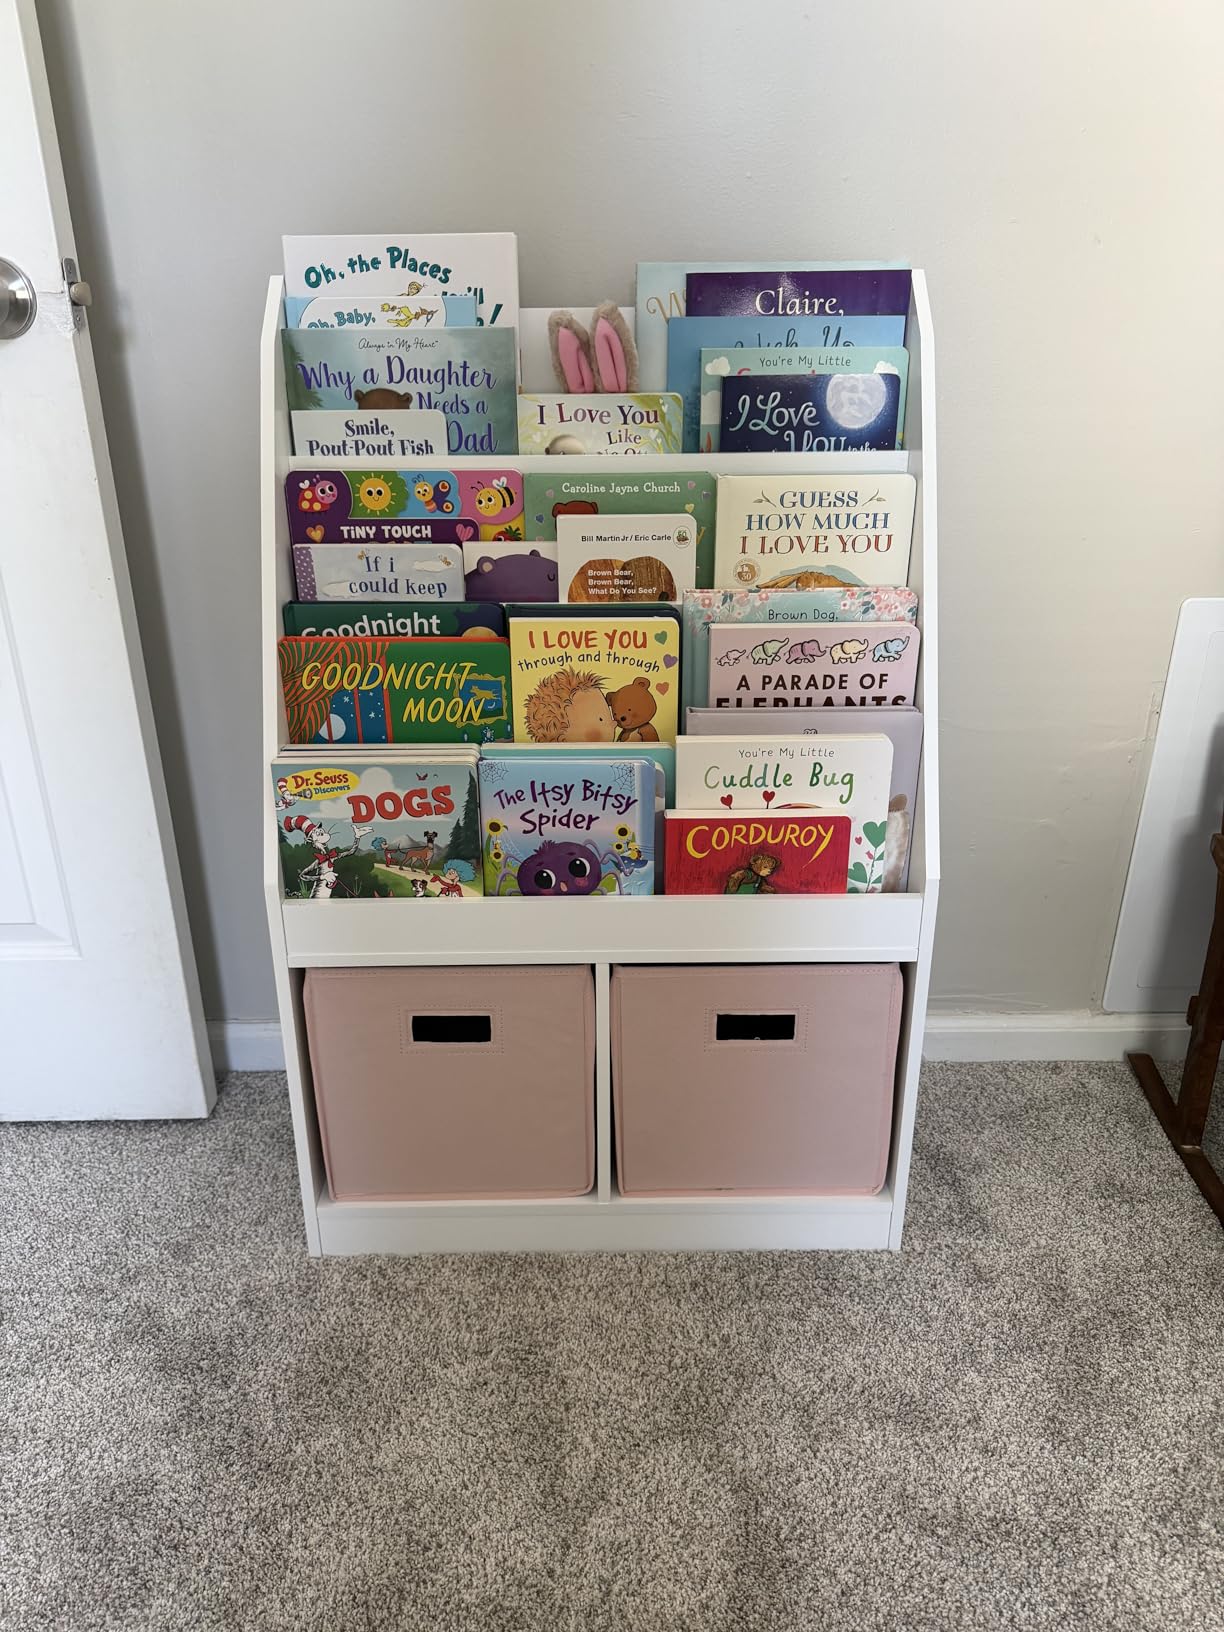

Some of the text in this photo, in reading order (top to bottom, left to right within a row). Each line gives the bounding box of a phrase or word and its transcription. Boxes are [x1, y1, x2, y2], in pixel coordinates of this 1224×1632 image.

[304, 246, 452, 289] Oh, the Places
[756, 289, 844, 316] Claire,
[358, 337, 385, 352] Always
[395, 337, 411, 352] My
[759, 355, 852, 368] You're My Little
[296, 356, 497, 400] Why a Daughter
[417, 392, 488, 414] Needs a
[537, 402, 660, 425] I Love You
[729, 392, 820, 435] I Love
[345, 418, 395, 437] Smile,
[447, 420, 499, 453] Dad
[606, 428, 642, 445] Like
[306, 439, 434, 456] Pout-Pout Fish
[562, 482, 681, 495] Caroline Jayne Church
[779, 490, 858, 508] GUESS
[745, 512, 890, 531] HOW MUCH
[381, 525, 432, 538] TOUCH
[634, 534, 650, 542] Eric
[739, 533, 894, 555] I LOVE YOU
[364, 555, 395, 573] If i
[613, 569, 634, 577] Bear,
[349, 578, 447, 597] could keep
[588, 578, 634, 586] Brown Bear,
[609, 587, 620, 595] Do
[621, 587, 637, 595] You
[768, 610, 808, 621] Brown
[528, 629, 648, 650] I LOVE YOU
[517, 651, 660, 673] through and through
[301, 662, 478, 690] GOODNIGHT
[736, 673, 888, 691] A PARADE OF
[402, 697, 485, 723] MOON
[738, 748, 835, 759] You're My Little
[292, 771, 349, 789] Dr. Seuss
[314, 784, 351, 795] Discovers
[704, 762, 854, 804] Cuddle Bug
[347, 785, 455, 824] DOGS
[493, 779, 638, 815] The Itsy Bitsy
[519, 808, 600, 836] Spider
[685, 823, 835, 868] CORDUROY
